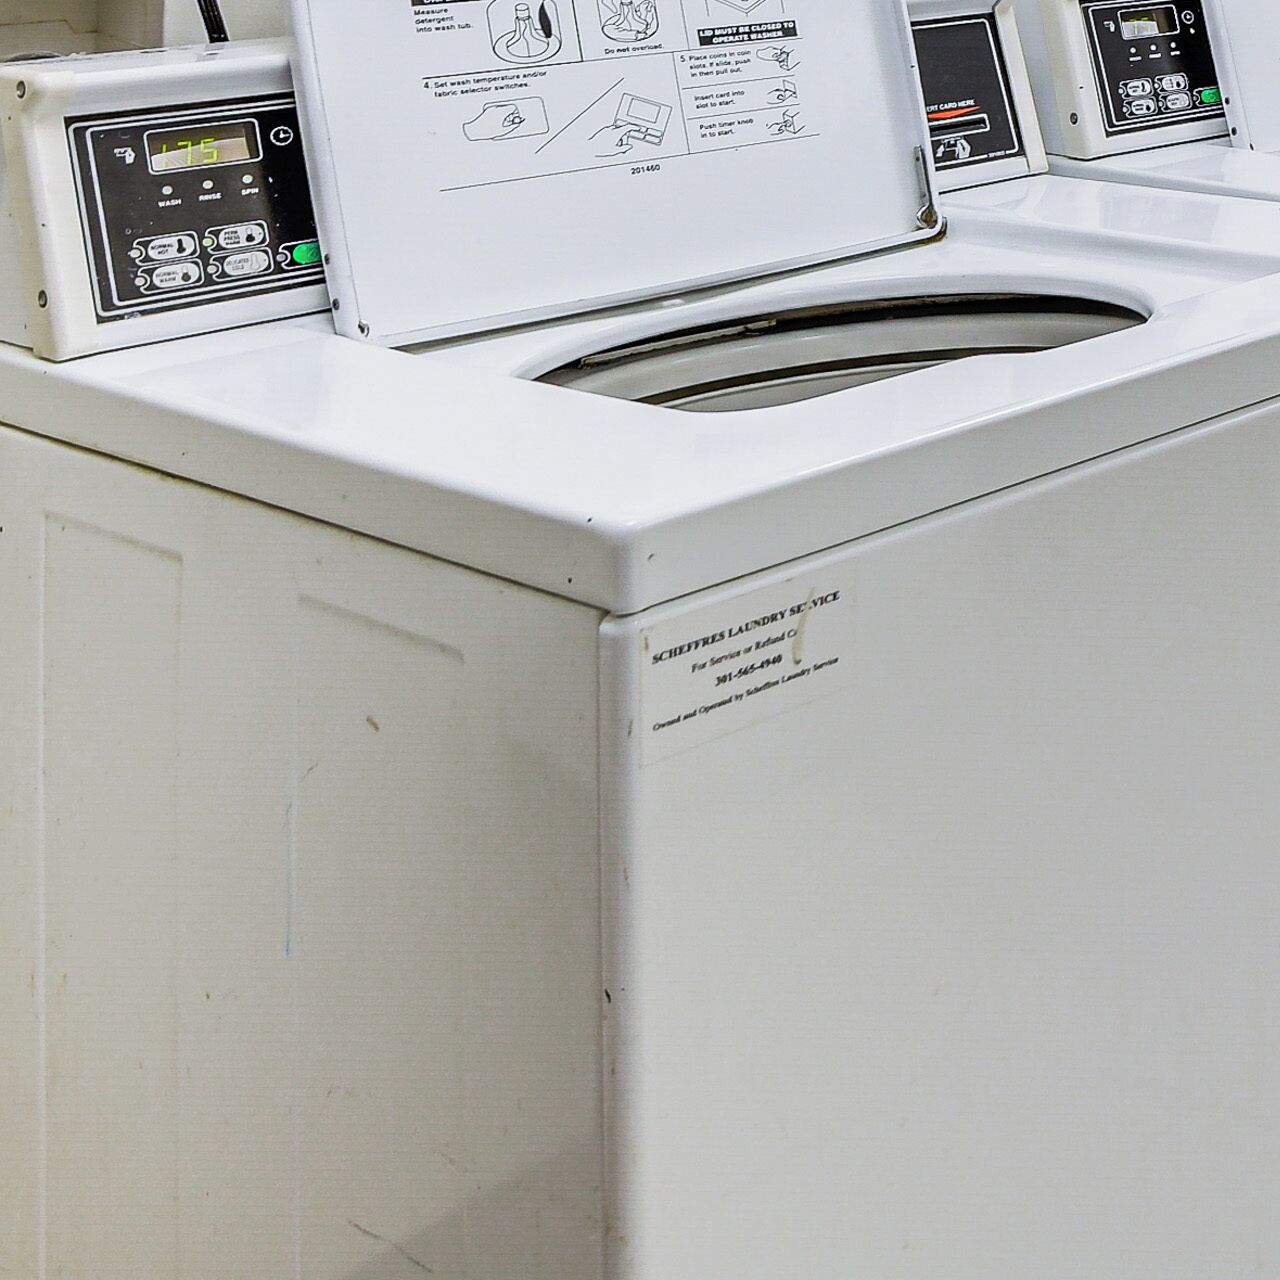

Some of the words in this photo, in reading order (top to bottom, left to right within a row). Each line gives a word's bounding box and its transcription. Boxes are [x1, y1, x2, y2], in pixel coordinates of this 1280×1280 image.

[415, 16, 454, 24] detergent
[752, 23, 781, 31] CLOSED
[713, 35, 749, 43] OPERATE
[473, 75, 520, 83] temperature
[461, 86, 491, 94] selector
[157, 198, 181, 207] WASH
[151, 243, 174, 251] NORMAL
[652, 631, 725, 665] SCHEFFRES
[728, 609, 787, 638] LAUNDRY
[789, 591, 840, 616] SEVICE
[691, 662, 706, 673] For
[709, 649, 741, 667] Service
[743, 645, 753, 654] or
[755, 632, 785, 650] Refund
